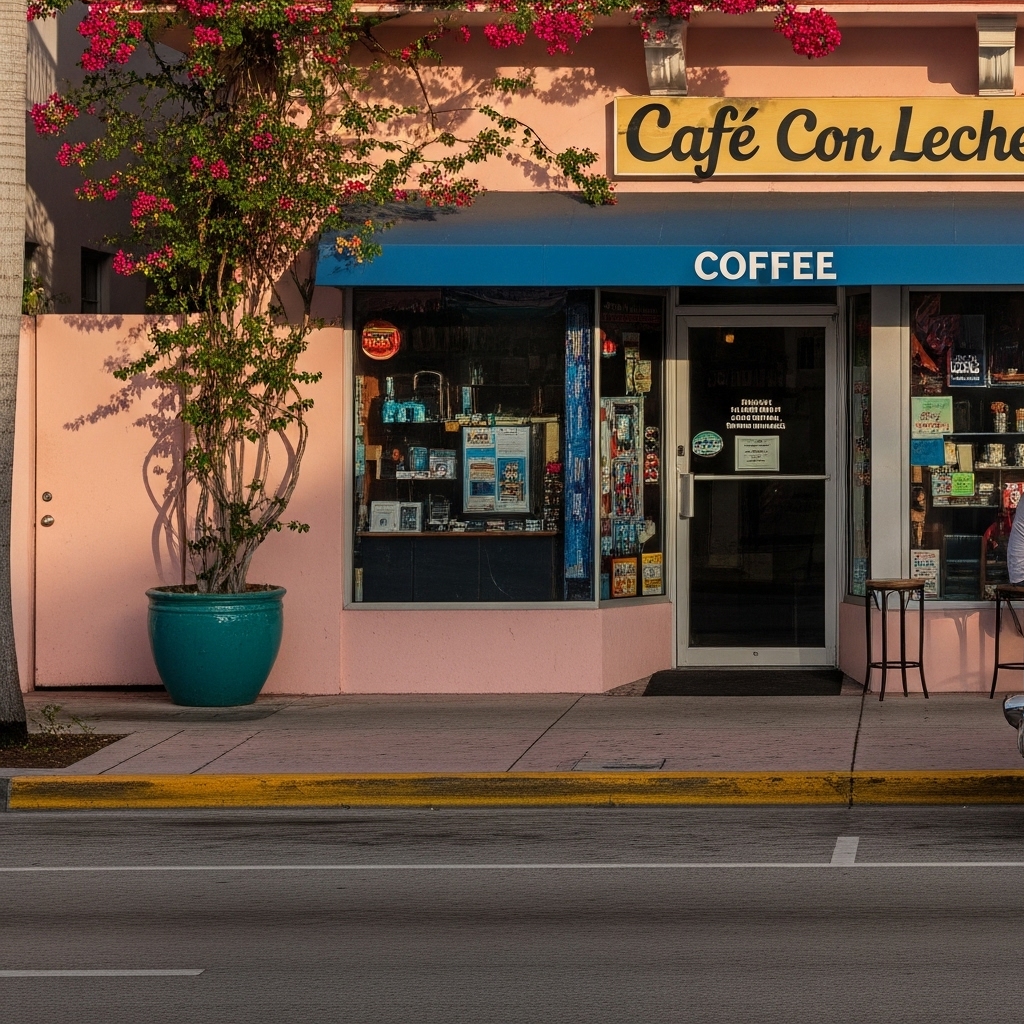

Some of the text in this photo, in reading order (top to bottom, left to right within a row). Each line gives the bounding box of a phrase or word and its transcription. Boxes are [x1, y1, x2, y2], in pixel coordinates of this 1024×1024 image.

[626, 103, 760, 178] Café
[776, 108, 882, 162] Con
[694, 250, 837, 281] COFFEE
